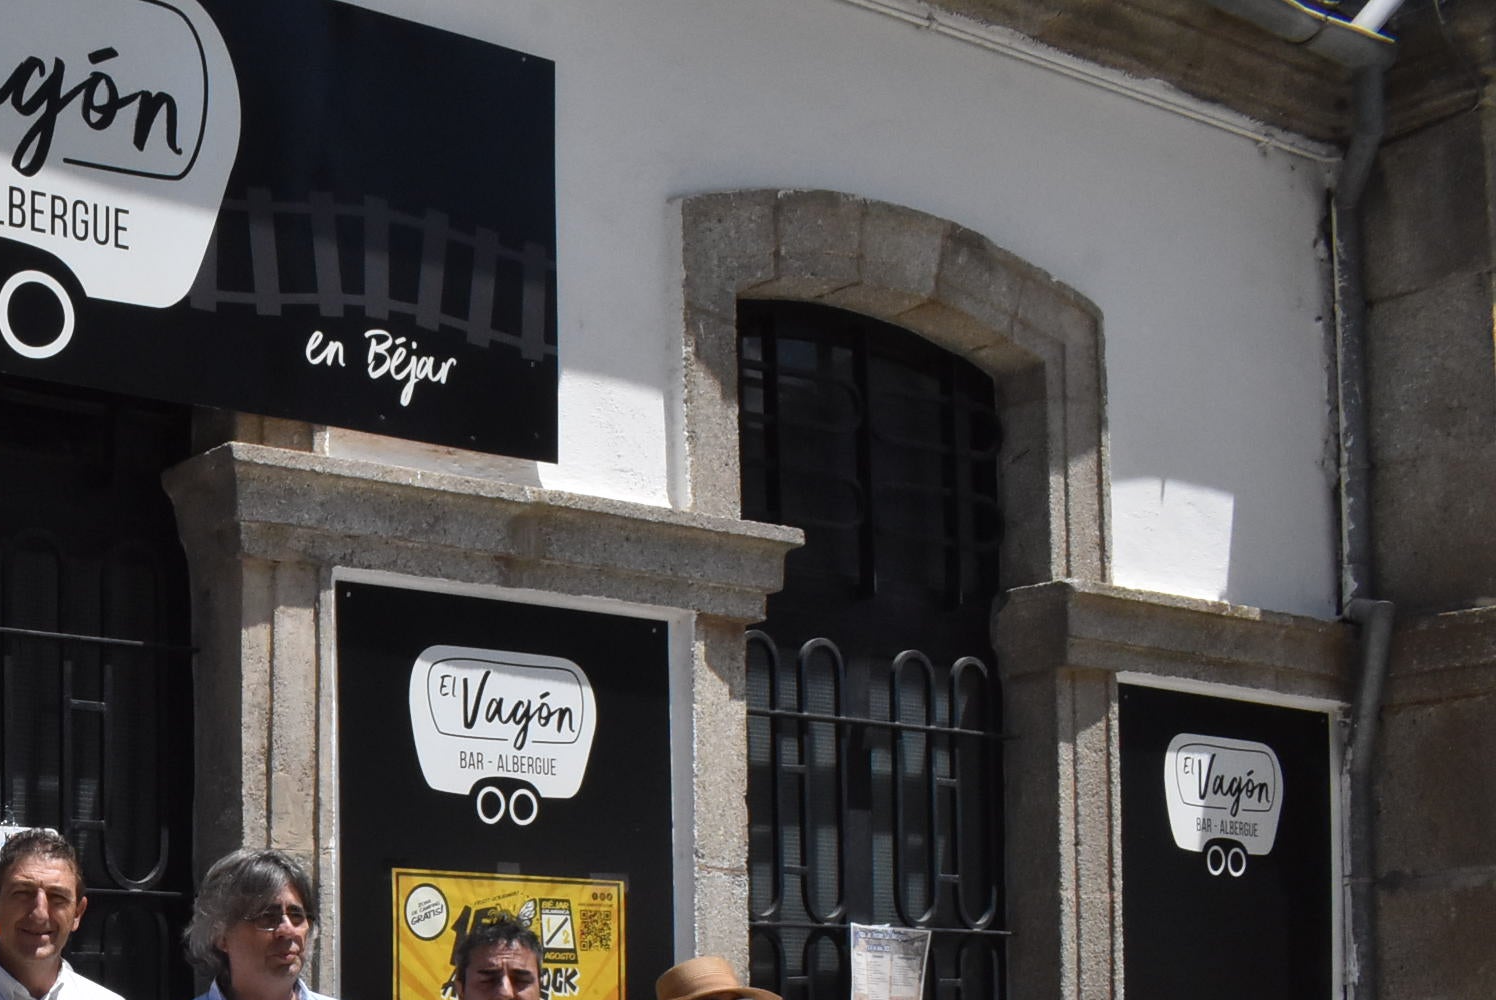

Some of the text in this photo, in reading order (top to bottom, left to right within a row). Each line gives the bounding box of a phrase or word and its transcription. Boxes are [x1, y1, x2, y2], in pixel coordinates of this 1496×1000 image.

[305, 329, 457, 407] en Béjar
[439, 669, 576, 751] El Vagón
[459, 751, 485, 771] BAR
[497, 754, 557, 776] ALBERGUE
[1197, 753, 1271, 818] Vagón
[1196, 817, 1212, 834] BAR
[1220, 820, 1259, 838] ALBERGUE
